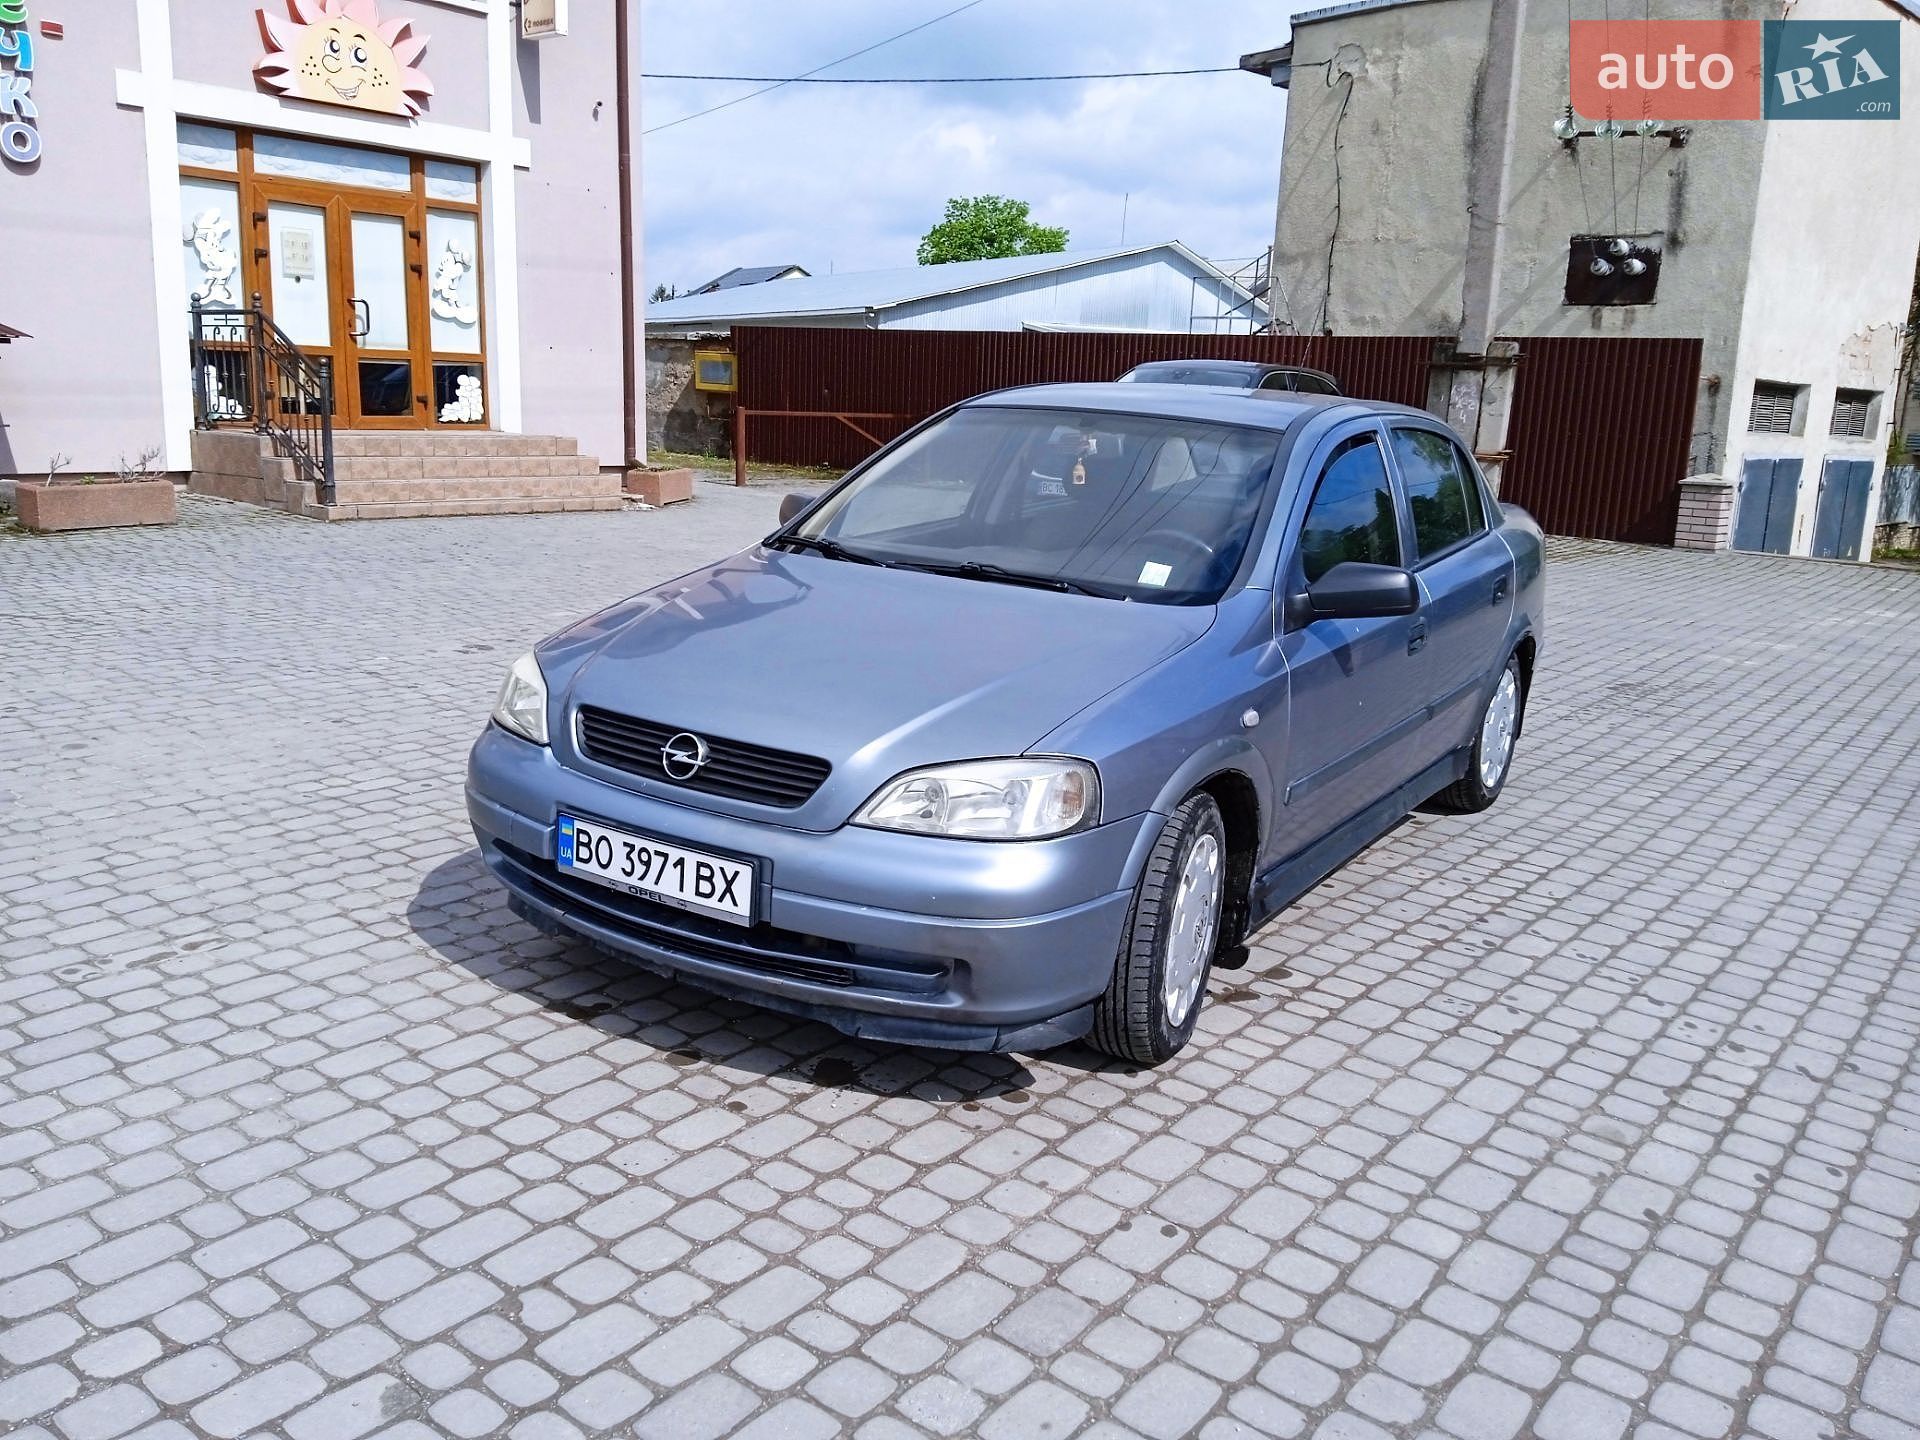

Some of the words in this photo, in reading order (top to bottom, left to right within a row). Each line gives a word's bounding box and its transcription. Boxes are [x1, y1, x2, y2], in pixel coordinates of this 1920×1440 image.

[560, 846, 573, 860] UA
[574, 827, 614, 870] BO
[620, 841, 686, 893] 3971
[694, 860, 741, 907] BX
[628, 885, 668, 904] OPEL
